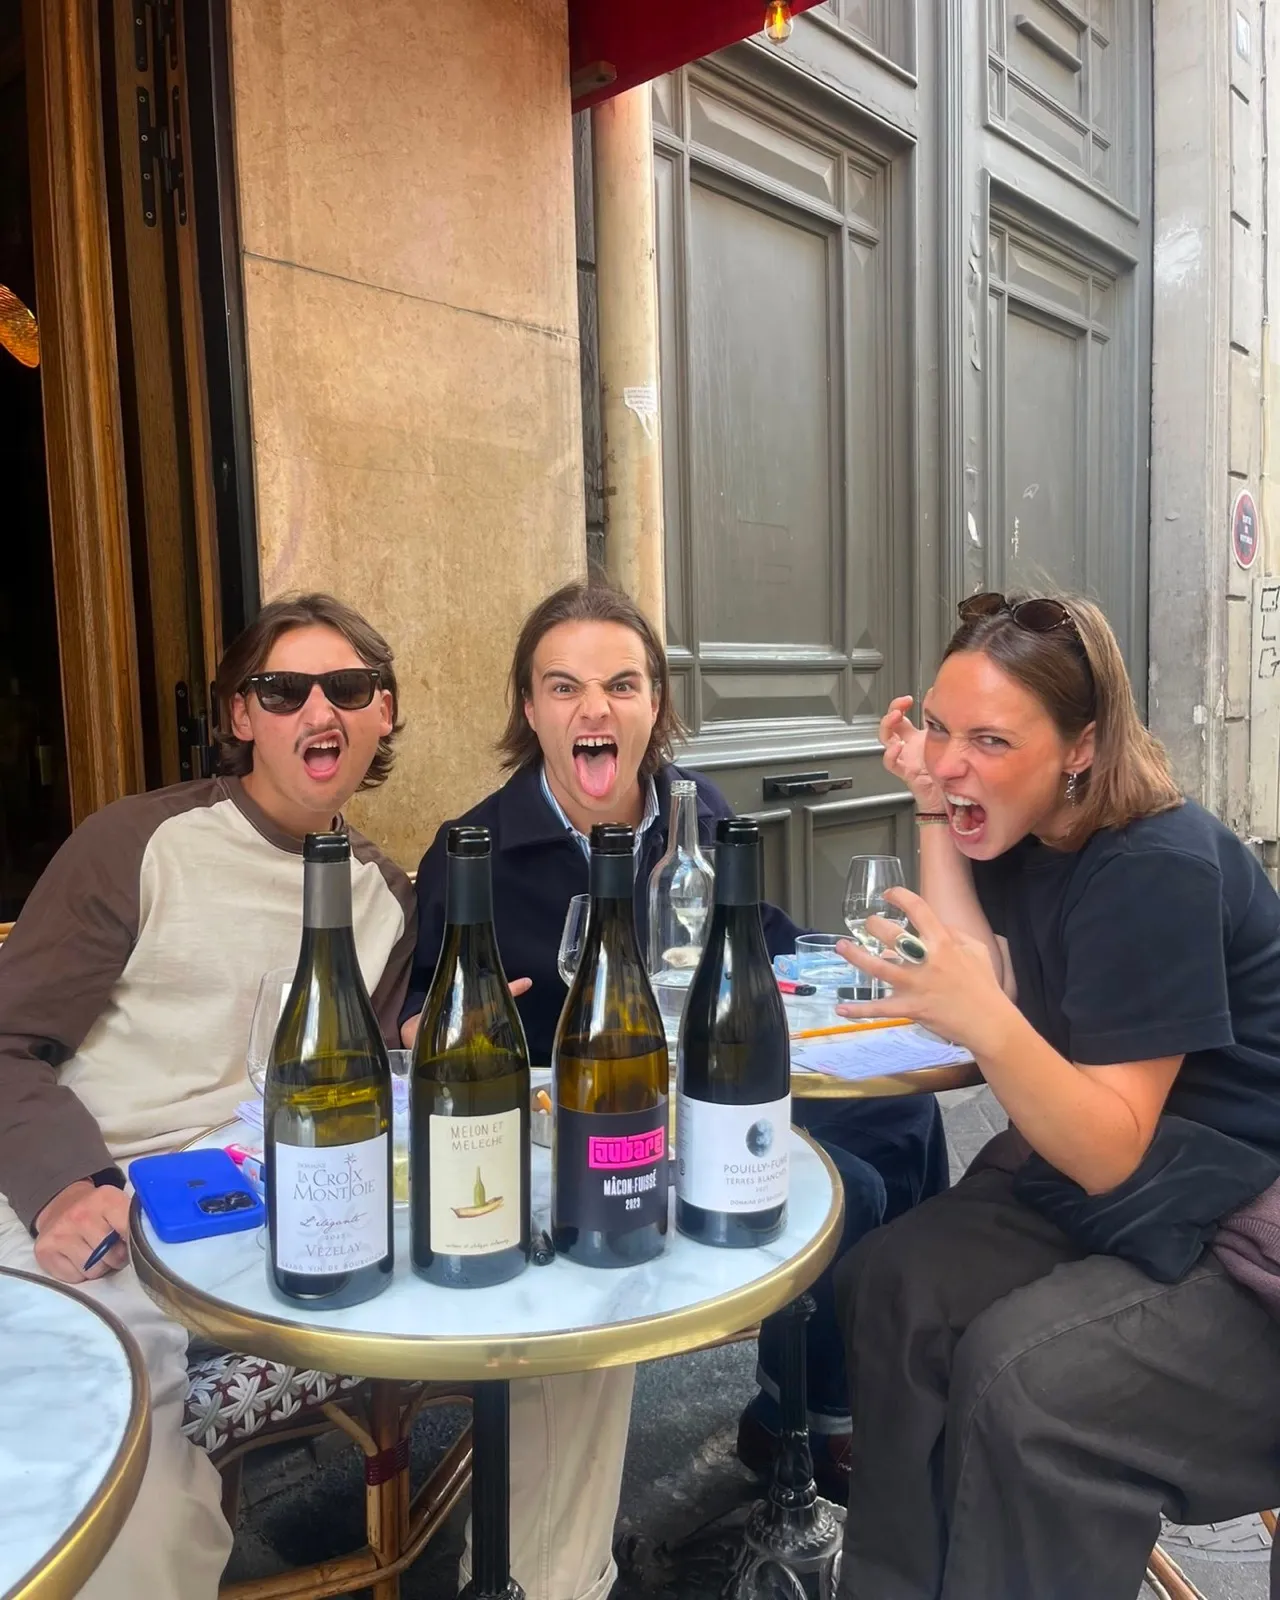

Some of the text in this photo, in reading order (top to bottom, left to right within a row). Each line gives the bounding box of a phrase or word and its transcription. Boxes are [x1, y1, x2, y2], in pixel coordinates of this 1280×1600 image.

[450, 1121, 505, 1139] MELON ET
[297, 1167, 364, 1187] LA CROIX
[603, 1168, 657, 1196] MÂCON-FUISSÉ
[726, 1177, 755, 1185] TERRES
[293, 1179, 376, 1202] MONTJOIE
[625, 1197, 641, 1210] 2023
